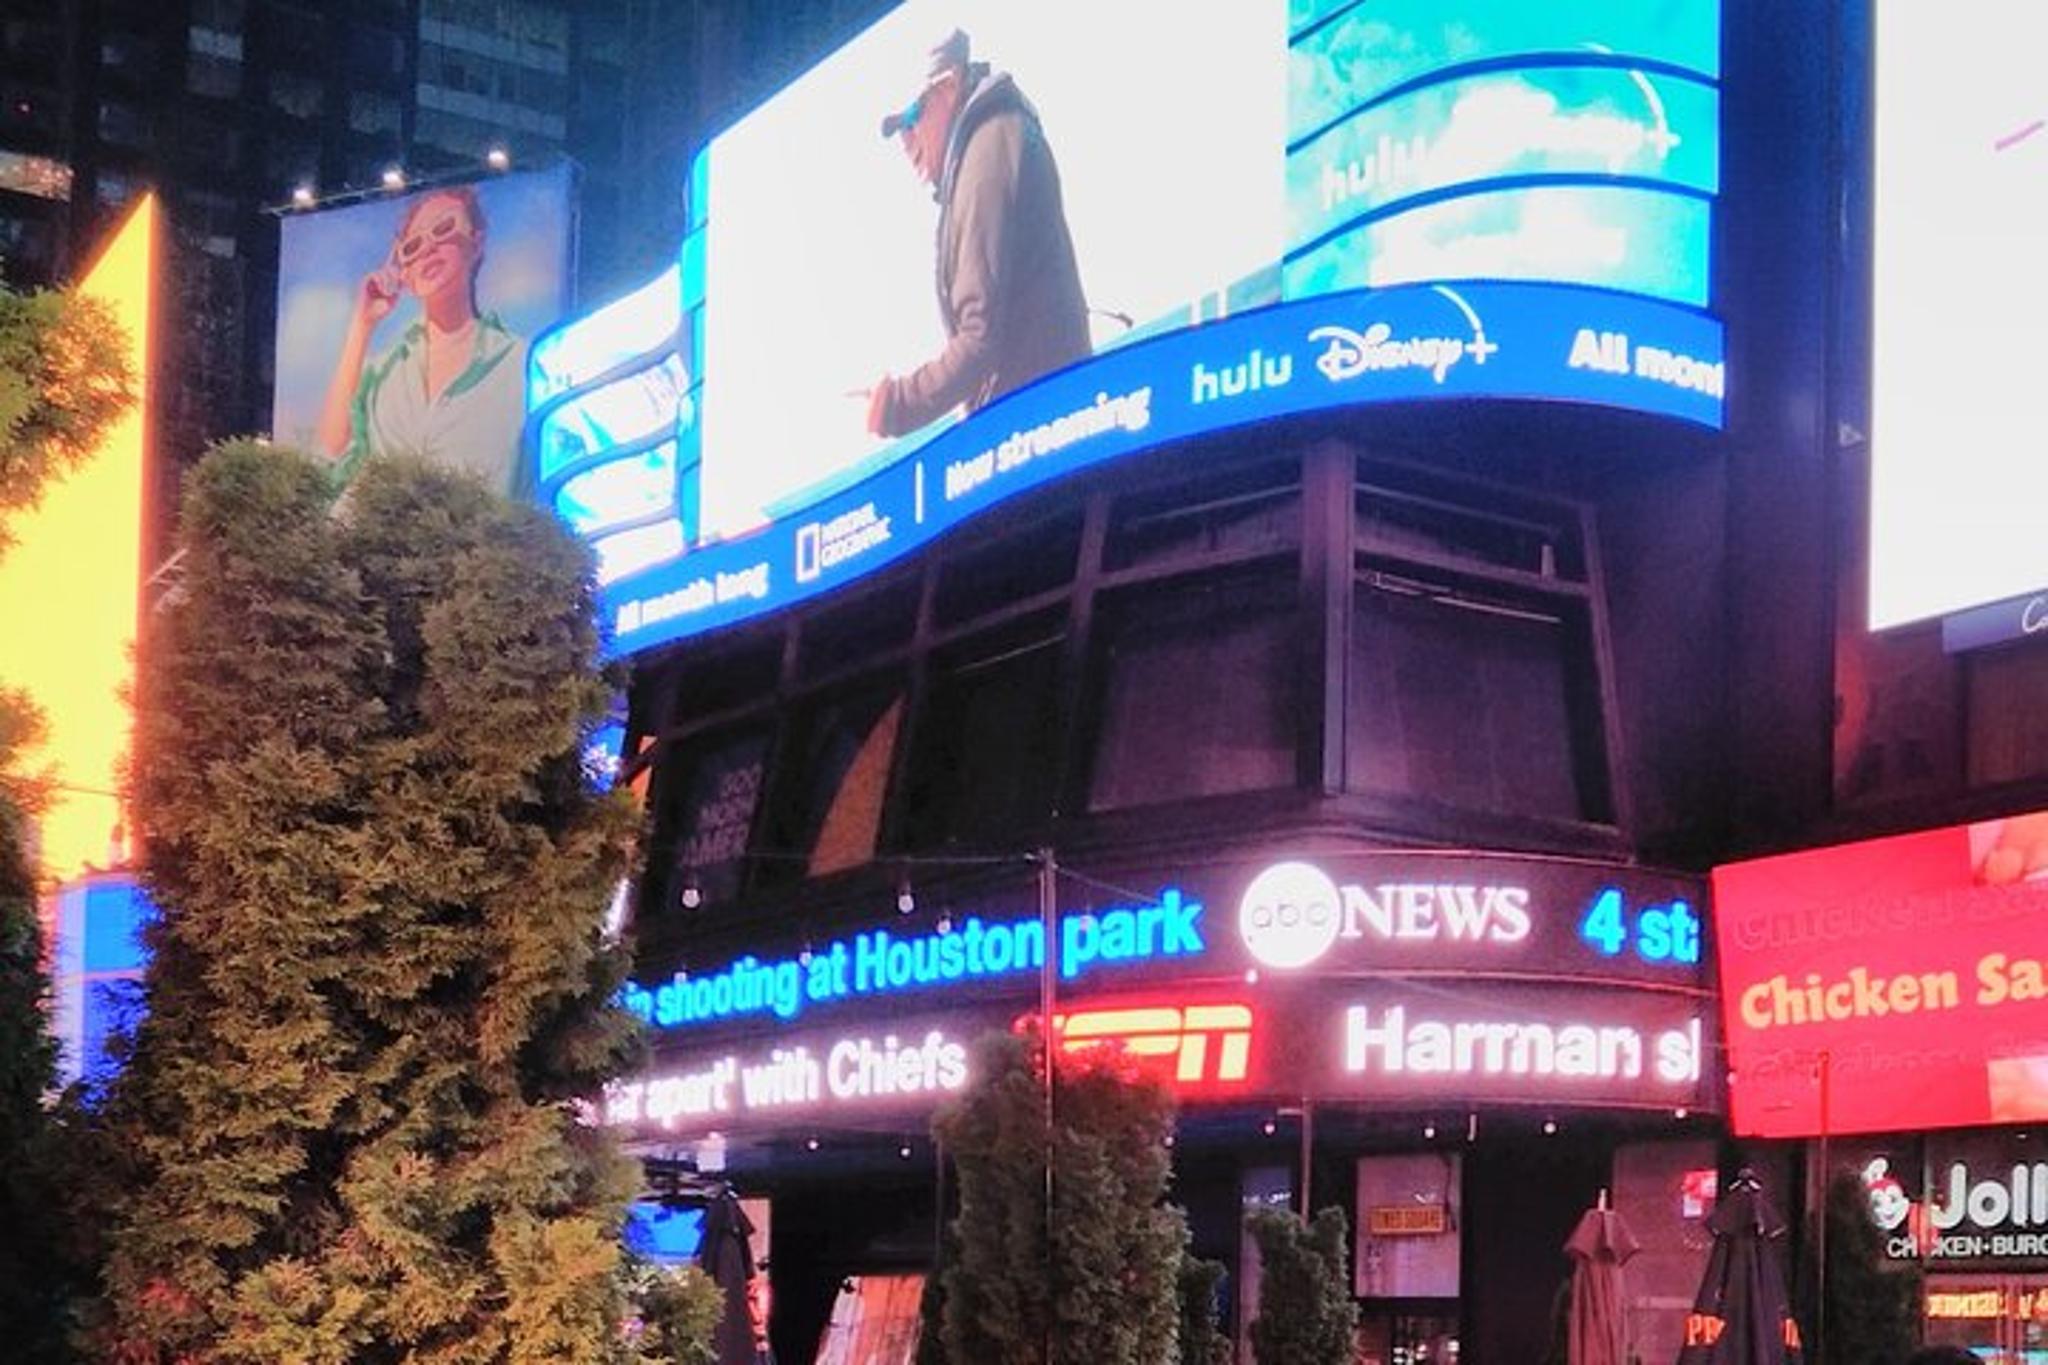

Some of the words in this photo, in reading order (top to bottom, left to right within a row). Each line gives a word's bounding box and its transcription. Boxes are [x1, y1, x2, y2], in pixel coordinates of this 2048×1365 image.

[997, 386, 1152, 474] streaming
[1192, 348, 1292, 404] hulu
[1568, 328, 1630, 374] All
[656, 956, 799, 1026] shooting
[806, 941, 847, 1000] at
[854, 916, 1043, 992] Houston
[1062, 888, 1203, 977] park
[1340, 885, 1531, 942] NEWS
[1582, 888, 1627, 955] 4
[1640, 900, 1699, 963] st
[1740, 966, 1960, 1030] Chicken
[742, 1046, 821, 1107] with
[827, 1031, 968, 1097] Chiefs
[1345, 1005, 1643, 1079] Harman
